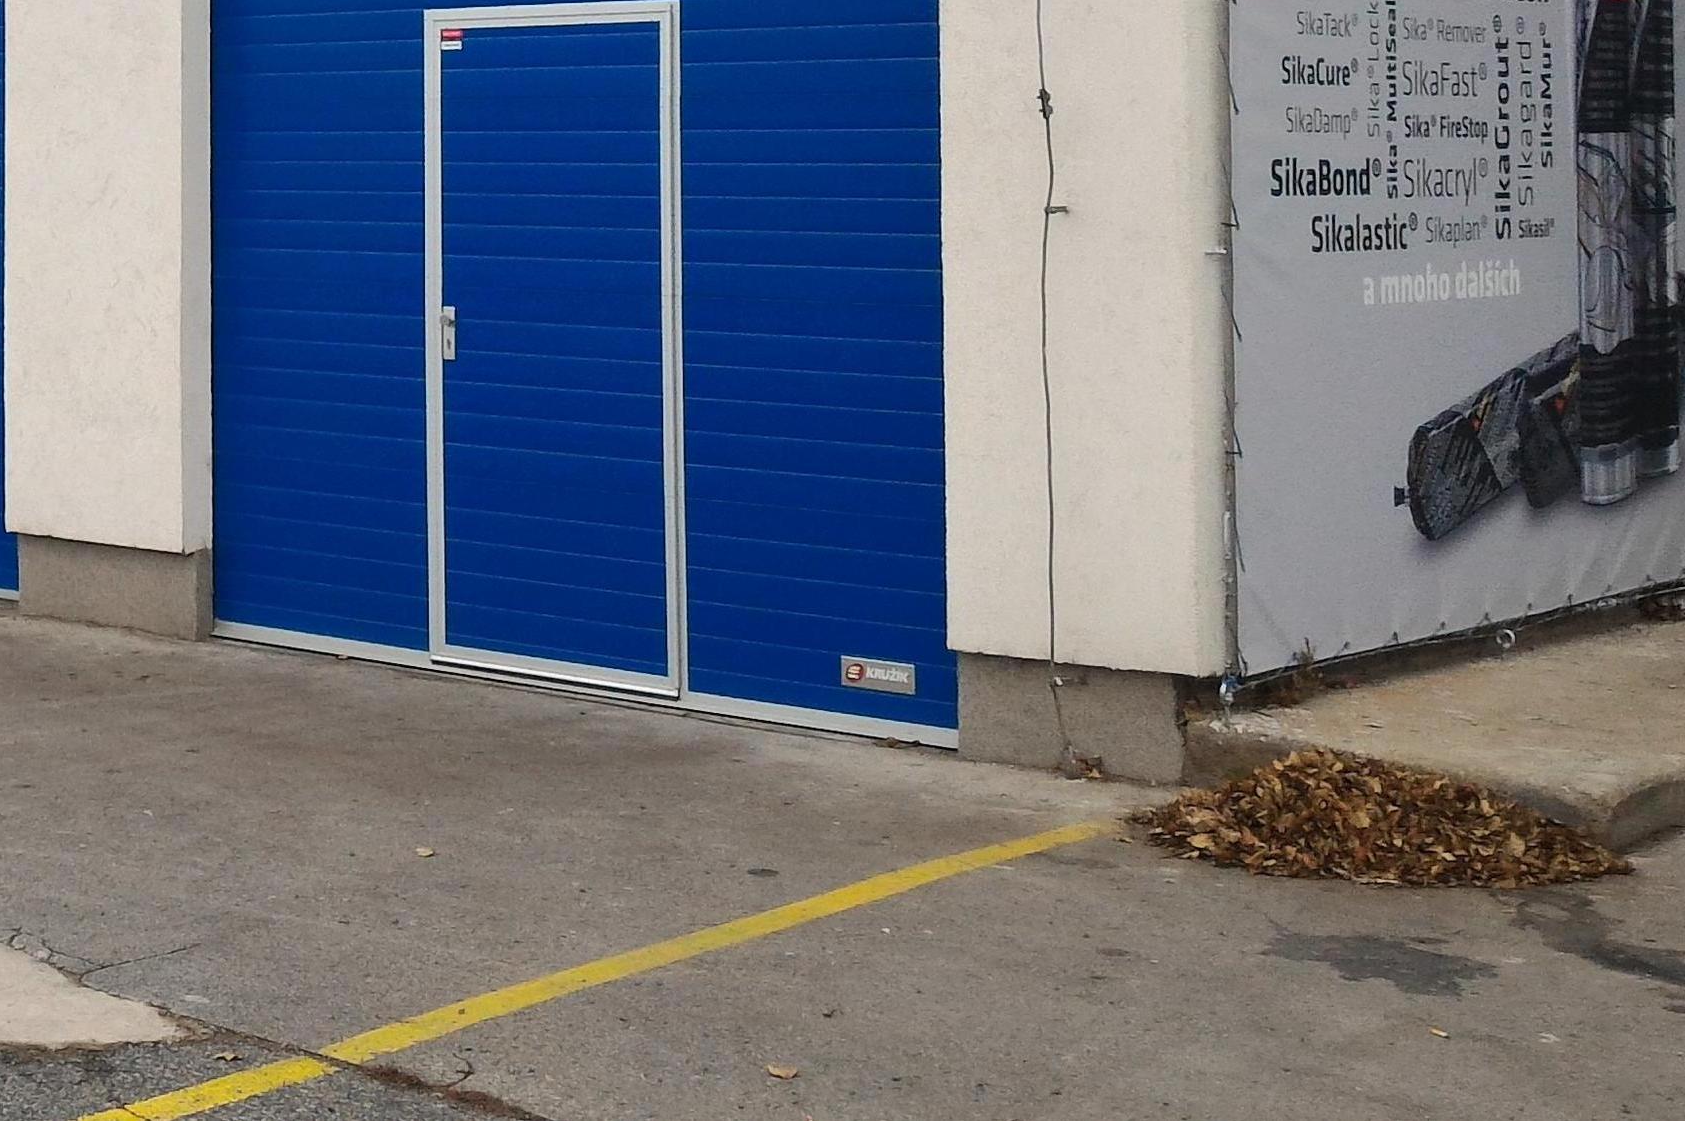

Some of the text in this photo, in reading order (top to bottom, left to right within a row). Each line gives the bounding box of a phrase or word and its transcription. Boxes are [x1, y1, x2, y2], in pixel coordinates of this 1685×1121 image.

[1437, 19, 1486, 43] Remover
[1386, 0, 1397, 122] MultiSeal
[1439, 116, 1488, 144] FireStop
[1363, 277, 1374, 305] a
[1380, 263, 1450, 305] mnoho
